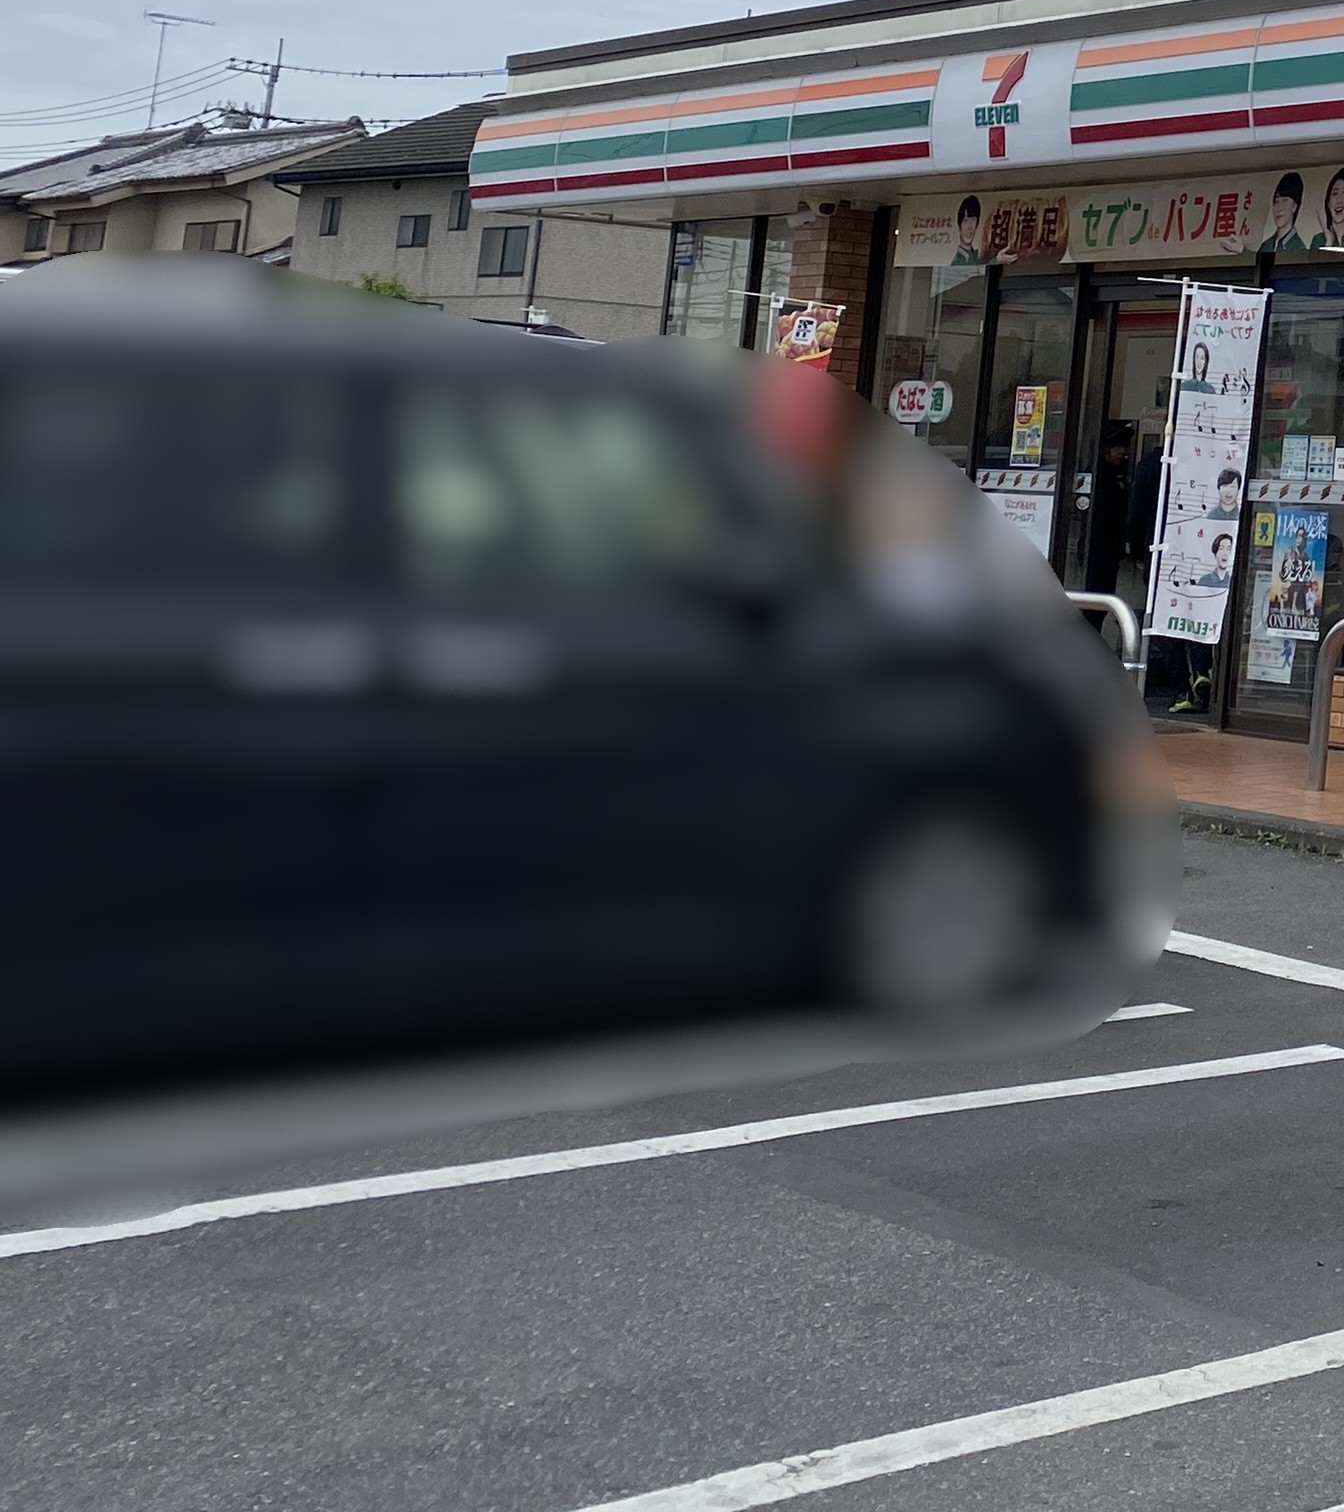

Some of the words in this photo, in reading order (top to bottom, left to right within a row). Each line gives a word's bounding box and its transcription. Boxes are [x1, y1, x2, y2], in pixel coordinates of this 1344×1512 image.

[990, 206, 1059, 249] 超満足
[896, 386, 926, 412] たばこ
[929, 387, 945, 412] 酒
